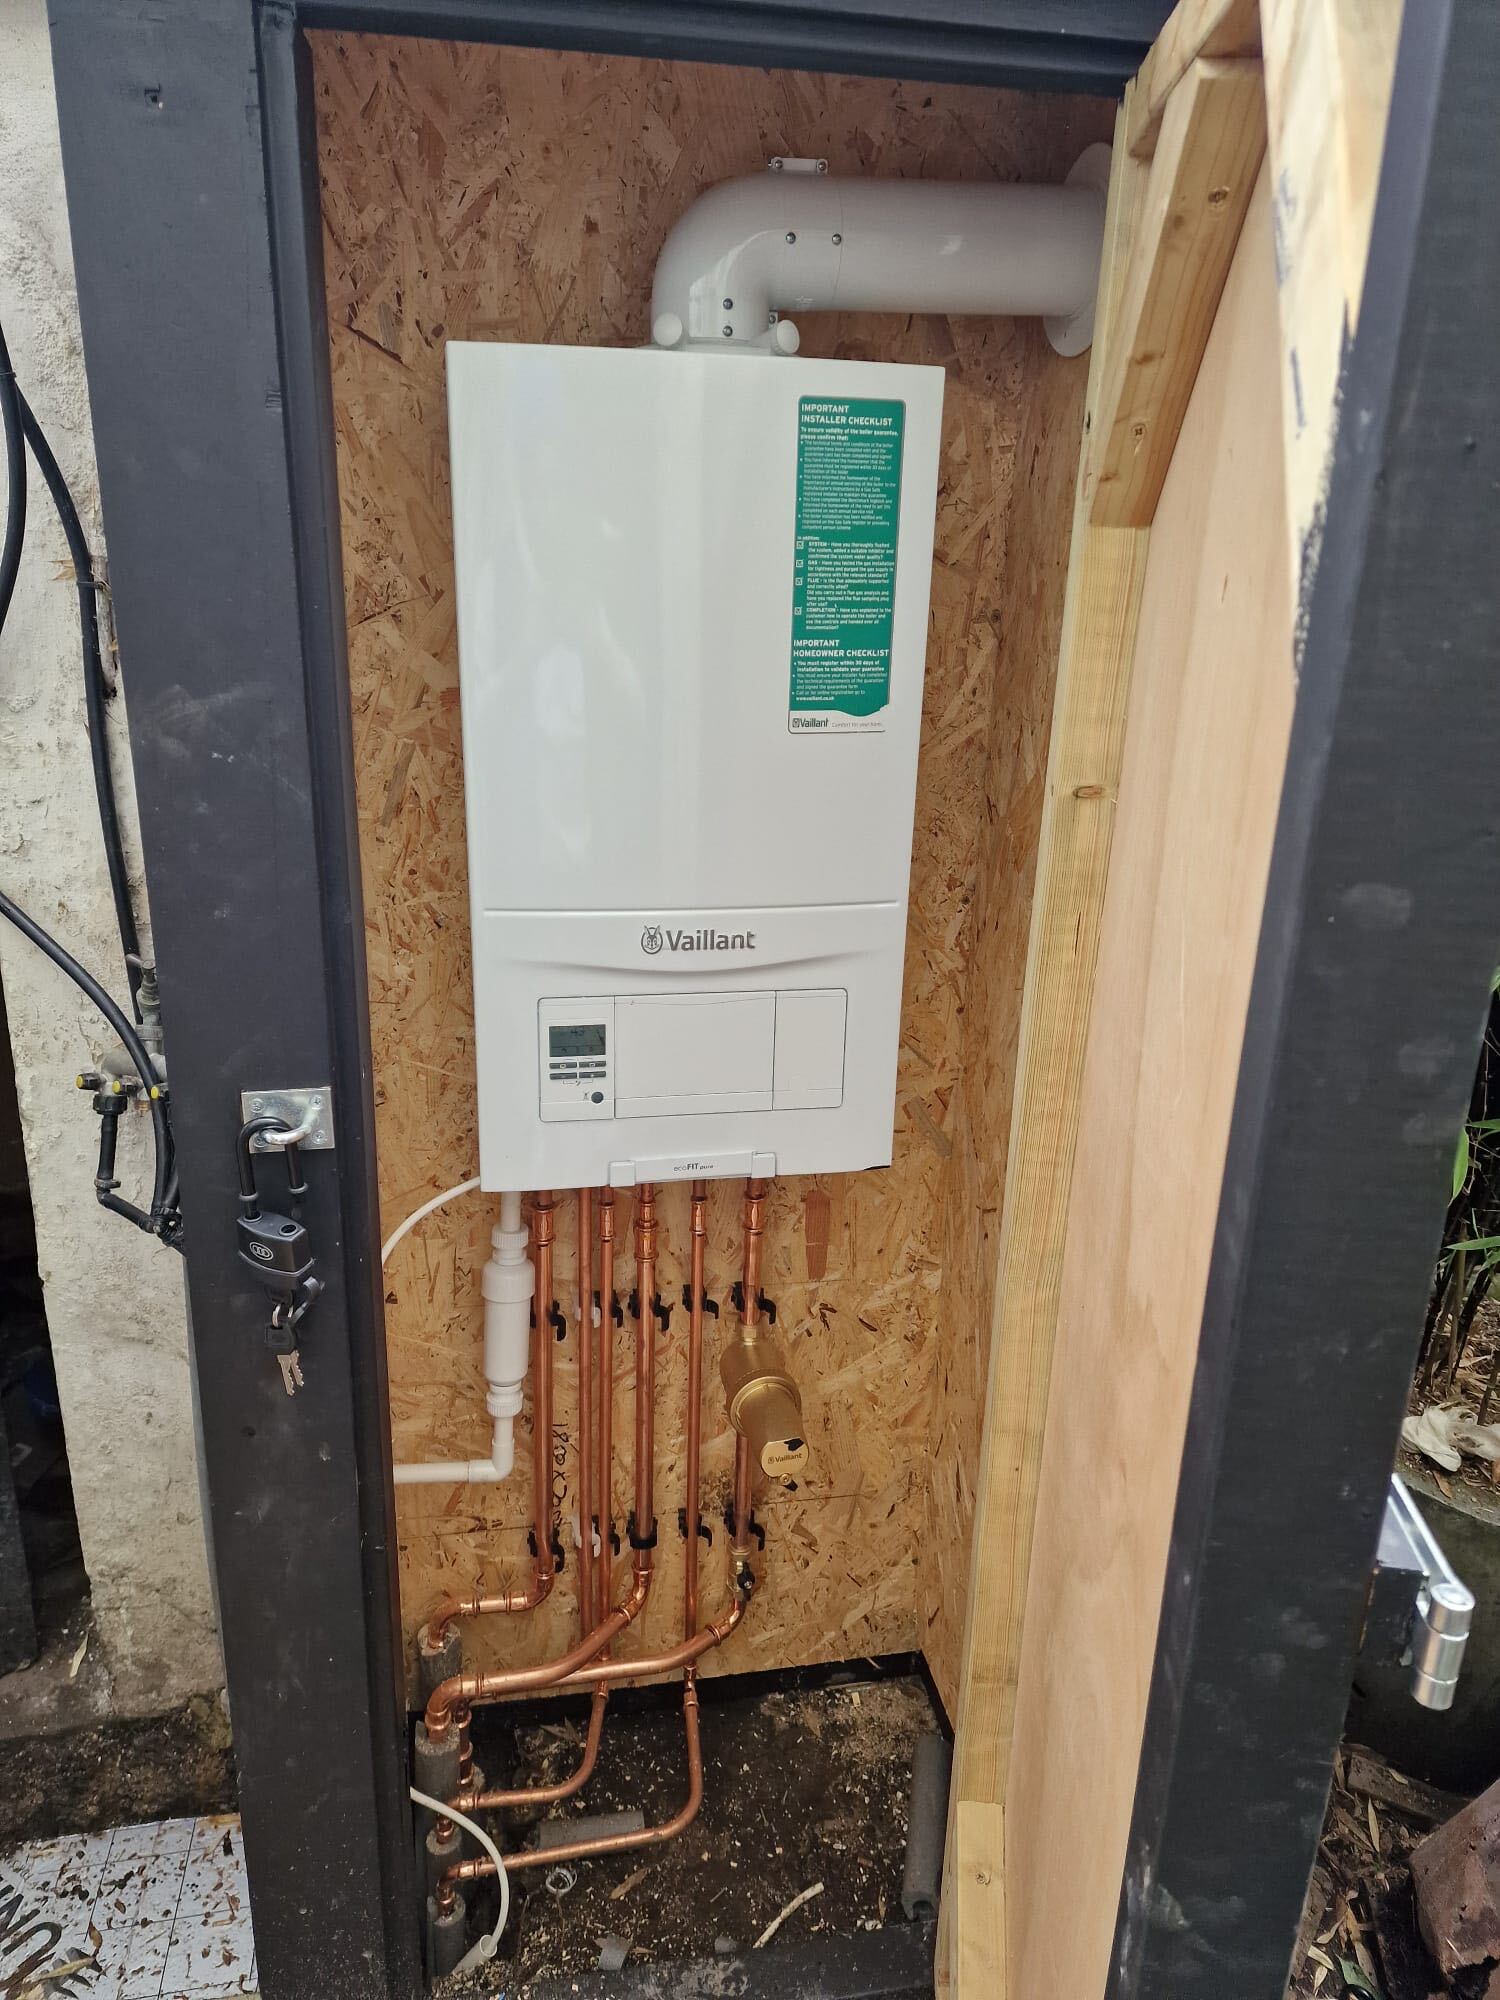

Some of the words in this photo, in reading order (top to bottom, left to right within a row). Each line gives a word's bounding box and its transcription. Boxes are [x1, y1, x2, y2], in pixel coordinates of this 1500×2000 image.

[801, 403, 849, 413] IMPORTANT
[801, 414, 846, 424] INSTALLER
[848, 416, 892, 426] CHECKLIST
[793, 649, 844, 657] HOMEOWNER
[799, 717, 828, 728] Vaillant
[665, 928, 756, 952] Vaillant
[673, 1162, 699, 1172] ecoFIT
[775, 1452, 802, 1464] Vaillant
